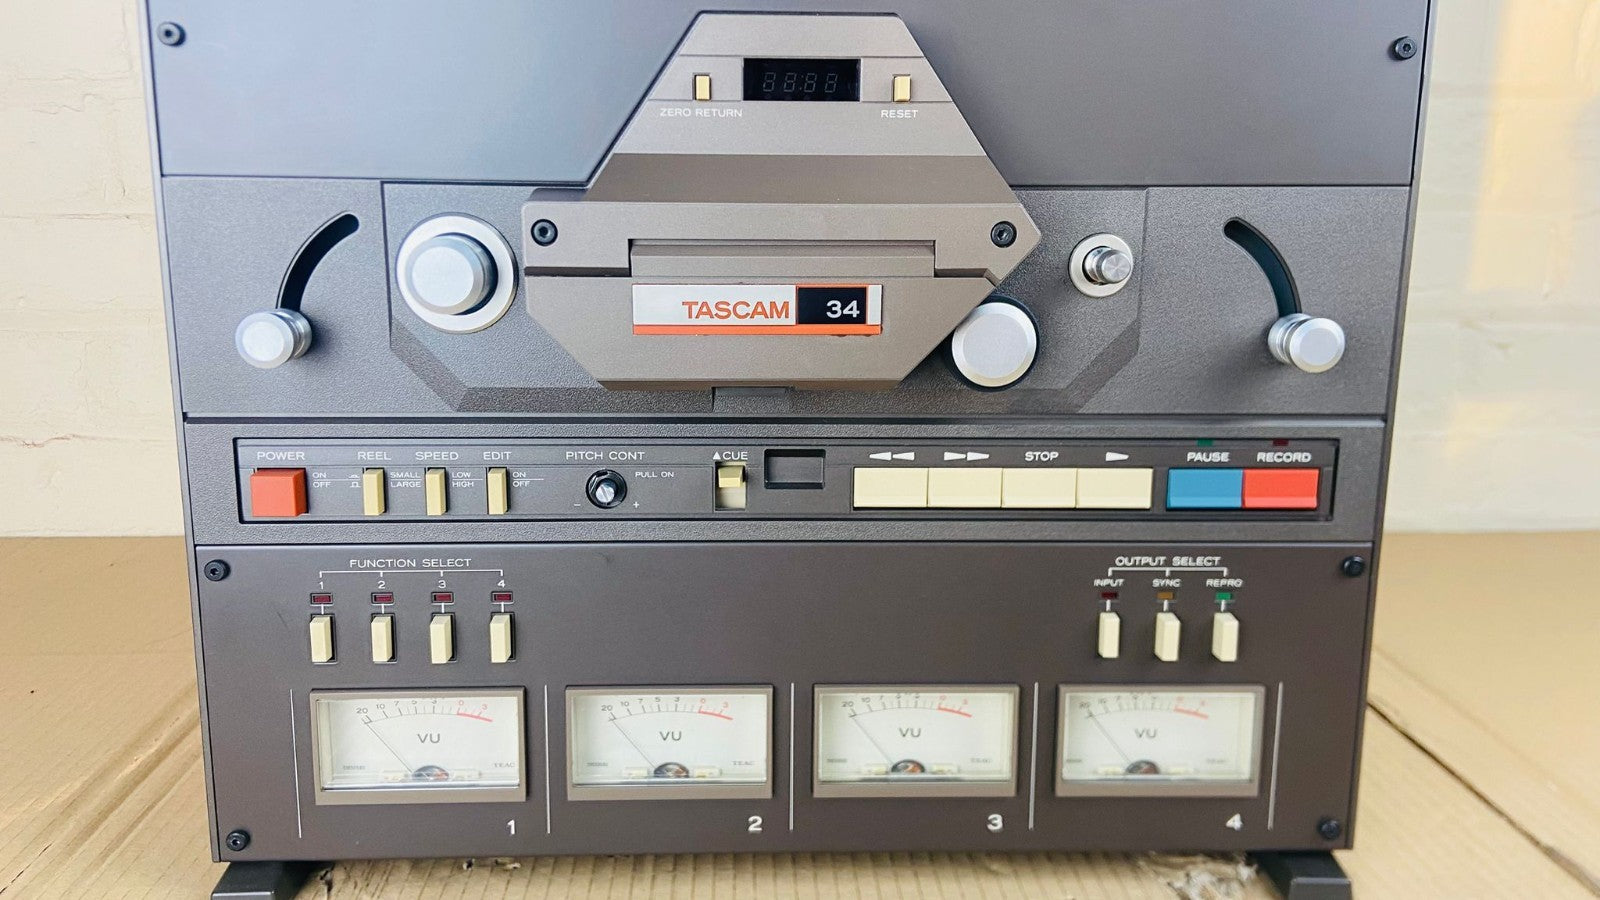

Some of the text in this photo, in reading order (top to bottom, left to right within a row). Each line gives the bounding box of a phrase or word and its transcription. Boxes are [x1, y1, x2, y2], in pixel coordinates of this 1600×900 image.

[659, 108, 744, 118] ZERO RETURN
[880, 109, 919, 119] RESET
[681, 299, 860, 320] TASCAM 34
[256, 451, 306, 461] POWER
[357, 451, 392, 461] REEL
[415, 451, 459, 461] SPEED
[483, 451, 512, 461] EDIT
[565, 450, 646, 461] PITCH CONT
[722, 451, 748, 461] CUE
[1025, 451, 1059, 462] STOP
[1186, 451, 1230, 463] PAUSE
[1256, 451, 1312, 463] RECORD
[390, 471, 422, 479] SMALL
[451, 471, 472, 479] LOW
[512, 471, 527, 479] ON
[634, 470, 676, 479] PULL ON
[312, 481, 332, 489] OFF
[390, 480, 423, 489] LARGE
[452, 480, 475, 489] HIGH
[512, 480, 531, 489] OFF
[349, 557, 473, 569] FUNCTION SELECT
[1114, 556, 1222, 567] OUTPUT SELECT
[377, 580, 387, 590] 2
[438, 579, 447, 589] 3
[497, 579, 506, 588] 4
[1093, 578, 1126, 588] INPUT
[1152, 578, 1183, 588] SYNC
[1205, 578, 1244, 588] REPRO
[600, 704, 613, 712] 20
[659, 730, 683, 742] VU
[898, 727, 922, 738] VU
[1134, 727, 1158, 739] VU
[417, 732, 442, 744] VU
[506, 819, 516, 835] 1
[747, 814, 763, 832] 2
[986, 813, 1004, 831] 3
[1225, 813, 1244, 831] 4
